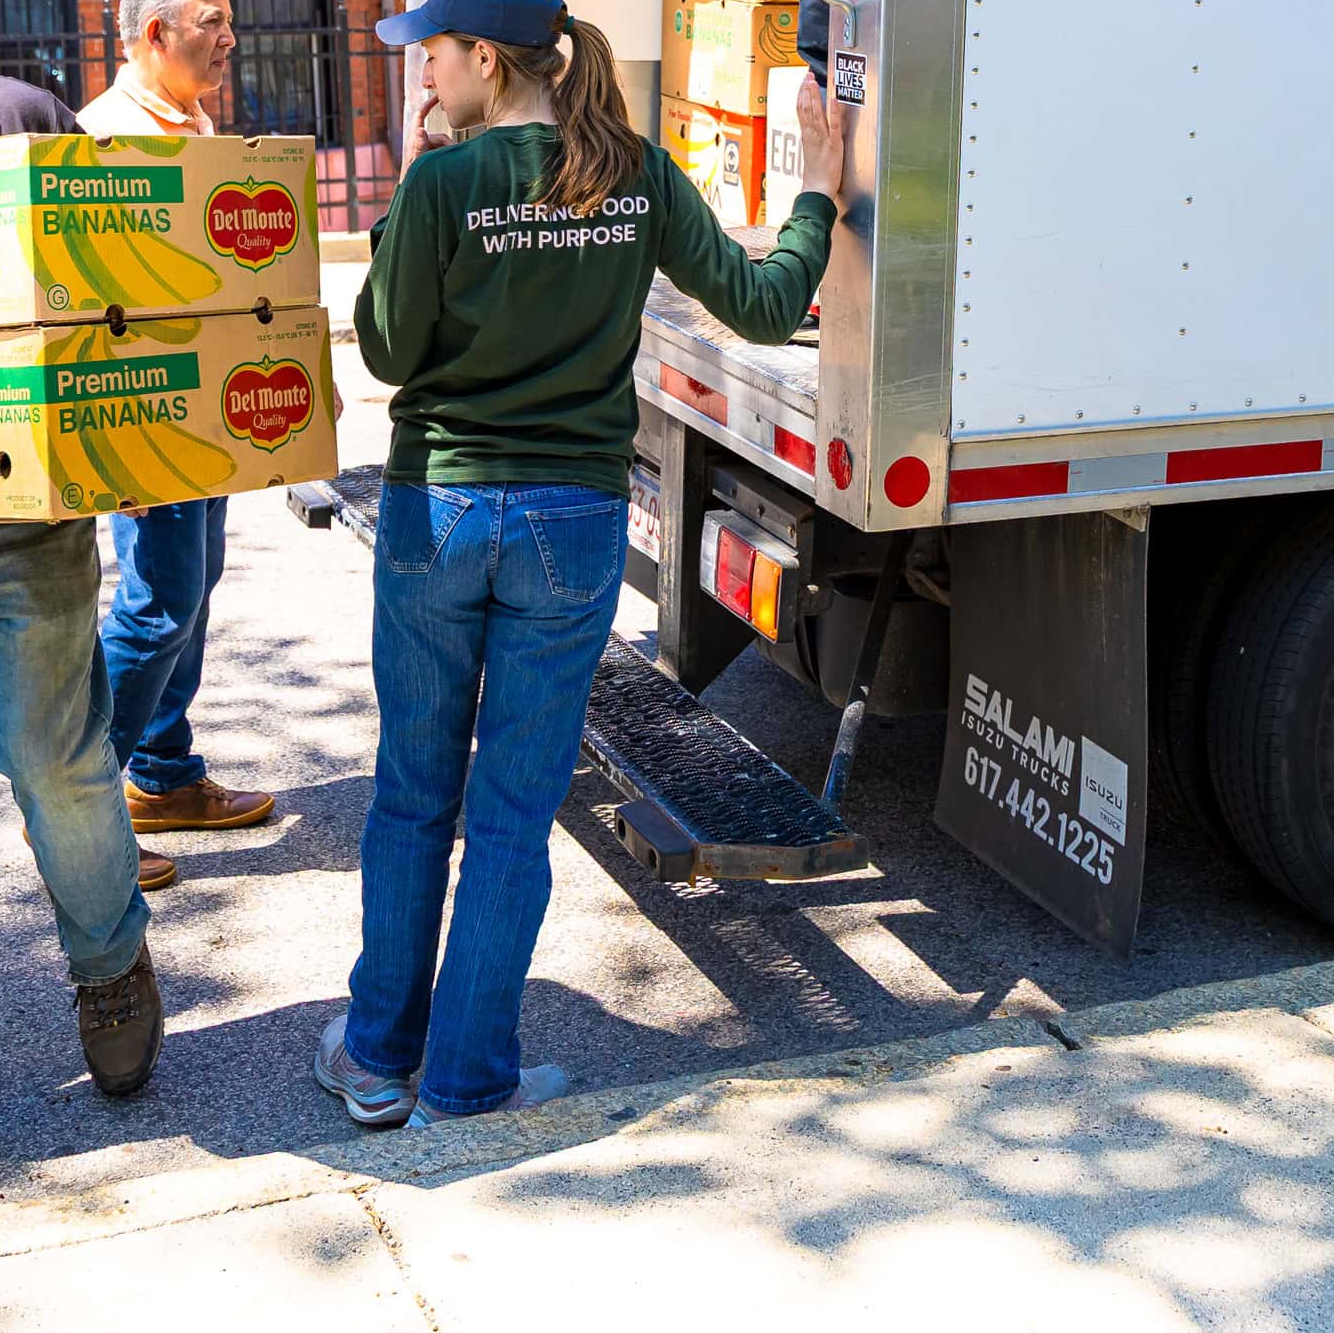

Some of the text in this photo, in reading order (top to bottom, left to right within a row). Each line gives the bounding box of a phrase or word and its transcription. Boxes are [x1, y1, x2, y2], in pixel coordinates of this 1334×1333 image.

[838, 58, 864, 73] BLACK
[838, 72, 863, 88] LIVES
[838, 86, 864, 99] MATTER
[41, 173, 151, 198] Premium
[43, 208, 171, 235] BANANAS
[213, 209, 293, 231] Del Monte
[236, 233, 271, 250] Quality
[483, 224, 636, 254] WITH PURPOSE
[51, 289, 65, 305] G
[57, 365, 168, 396] Premium
[229, 384, 307, 414] Del Monte
[59, 396, 188, 434] BANANAS
[252, 413, 286, 430] Quality
[68, 489, 79, 503] E
[964, 674, 1075, 778] SALAMI
[961, 710, 1069, 797] ISUZU TRUCKS
[1085, 775, 1123, 811] ISUZU
[964, 747, 1115, 885] 617.442.1225
[1099, 812, 1122, 832] TRUCK
